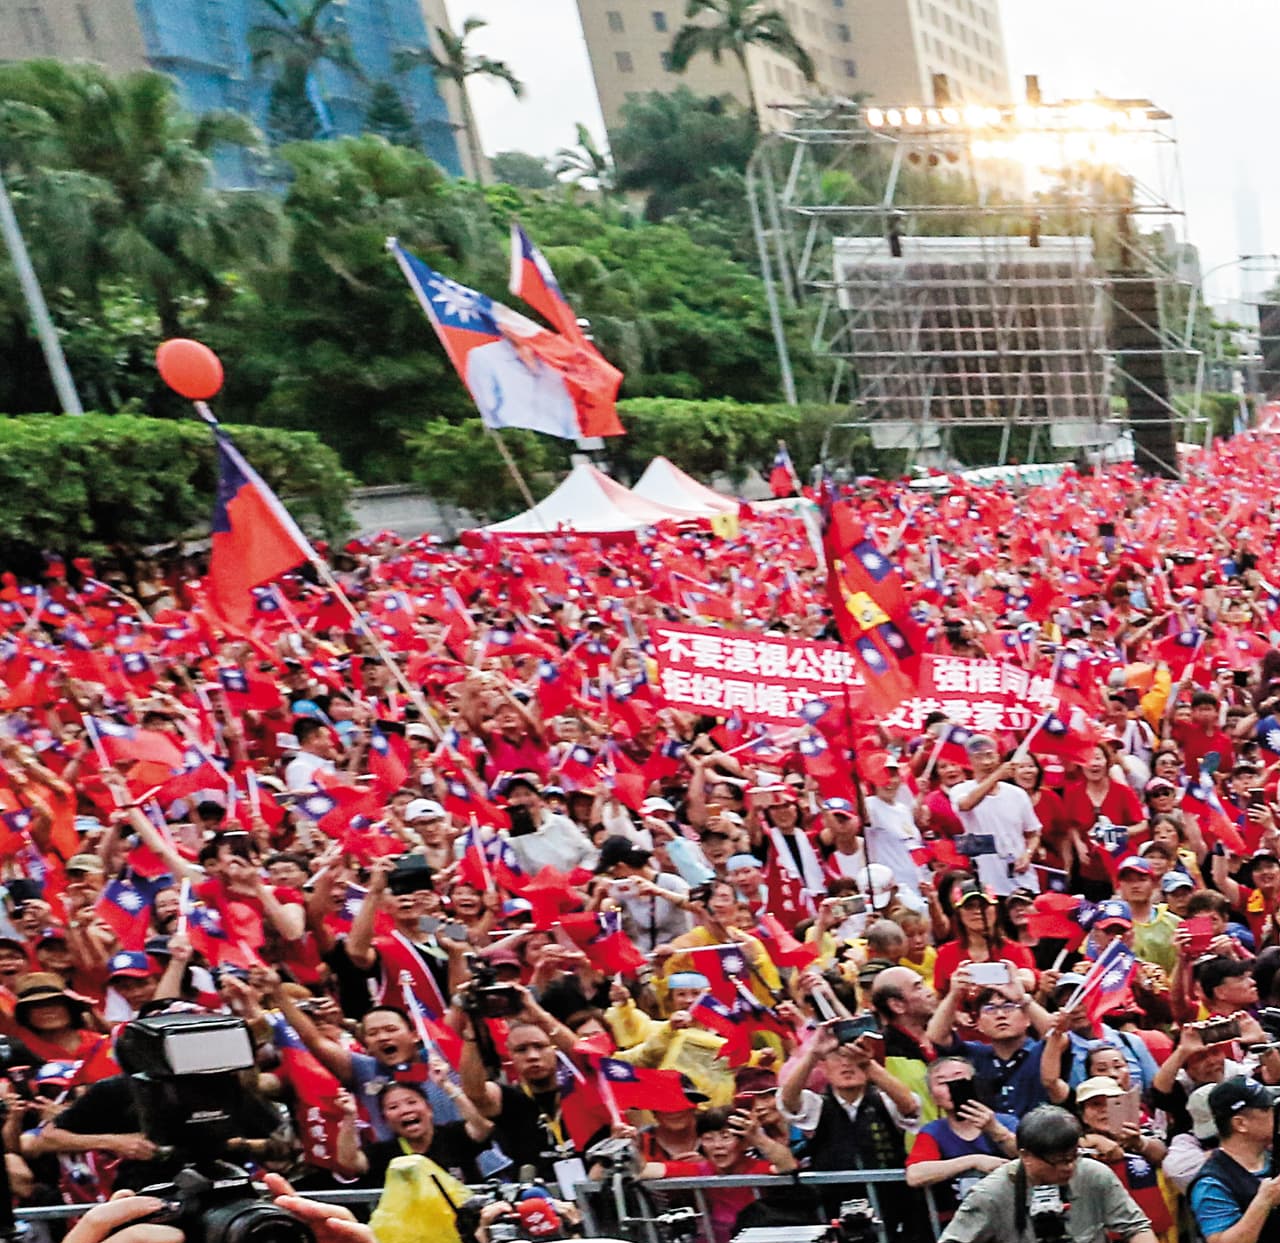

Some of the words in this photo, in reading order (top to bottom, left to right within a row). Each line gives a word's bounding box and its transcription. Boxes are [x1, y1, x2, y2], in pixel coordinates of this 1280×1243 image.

[656, 628, 866, 686] 不要漠視公投
[660, 667, 847, 718] 拒投同婚立
[879, 696, 1045, 731] 支持愛家立
